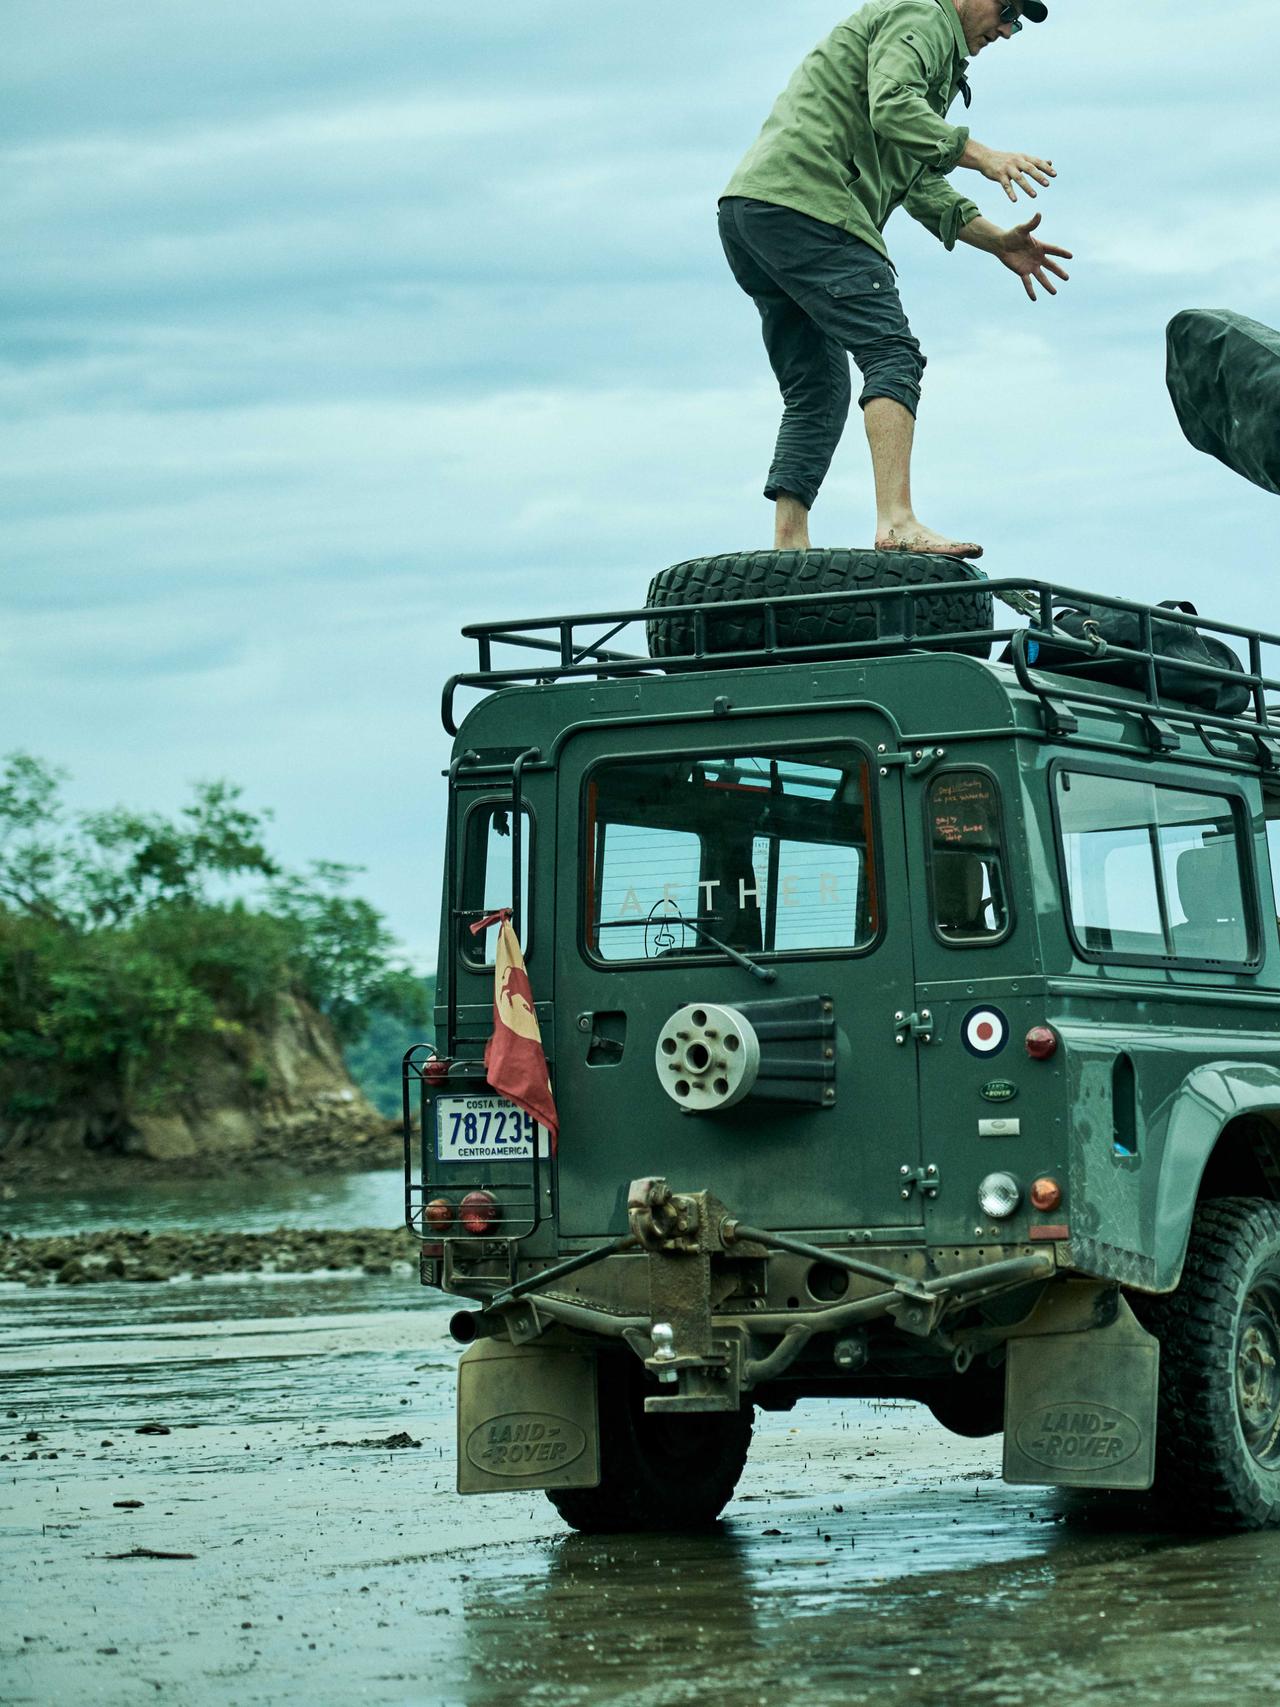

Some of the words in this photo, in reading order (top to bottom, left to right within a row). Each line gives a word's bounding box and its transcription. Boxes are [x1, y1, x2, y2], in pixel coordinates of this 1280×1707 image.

[617, 872, 840, 918] AETHER
[466, 1100, 495, 1109] COSTA
[458, 1146, 529, 1157] CENTROAMERICA
[488, 1423, 545, 1444] LAND
[1041, 1413, 1101, 1434] LAND
[492, 1442, 568, 1464] ROVER
[1046, 1435, 1124, 1457] ROVER
